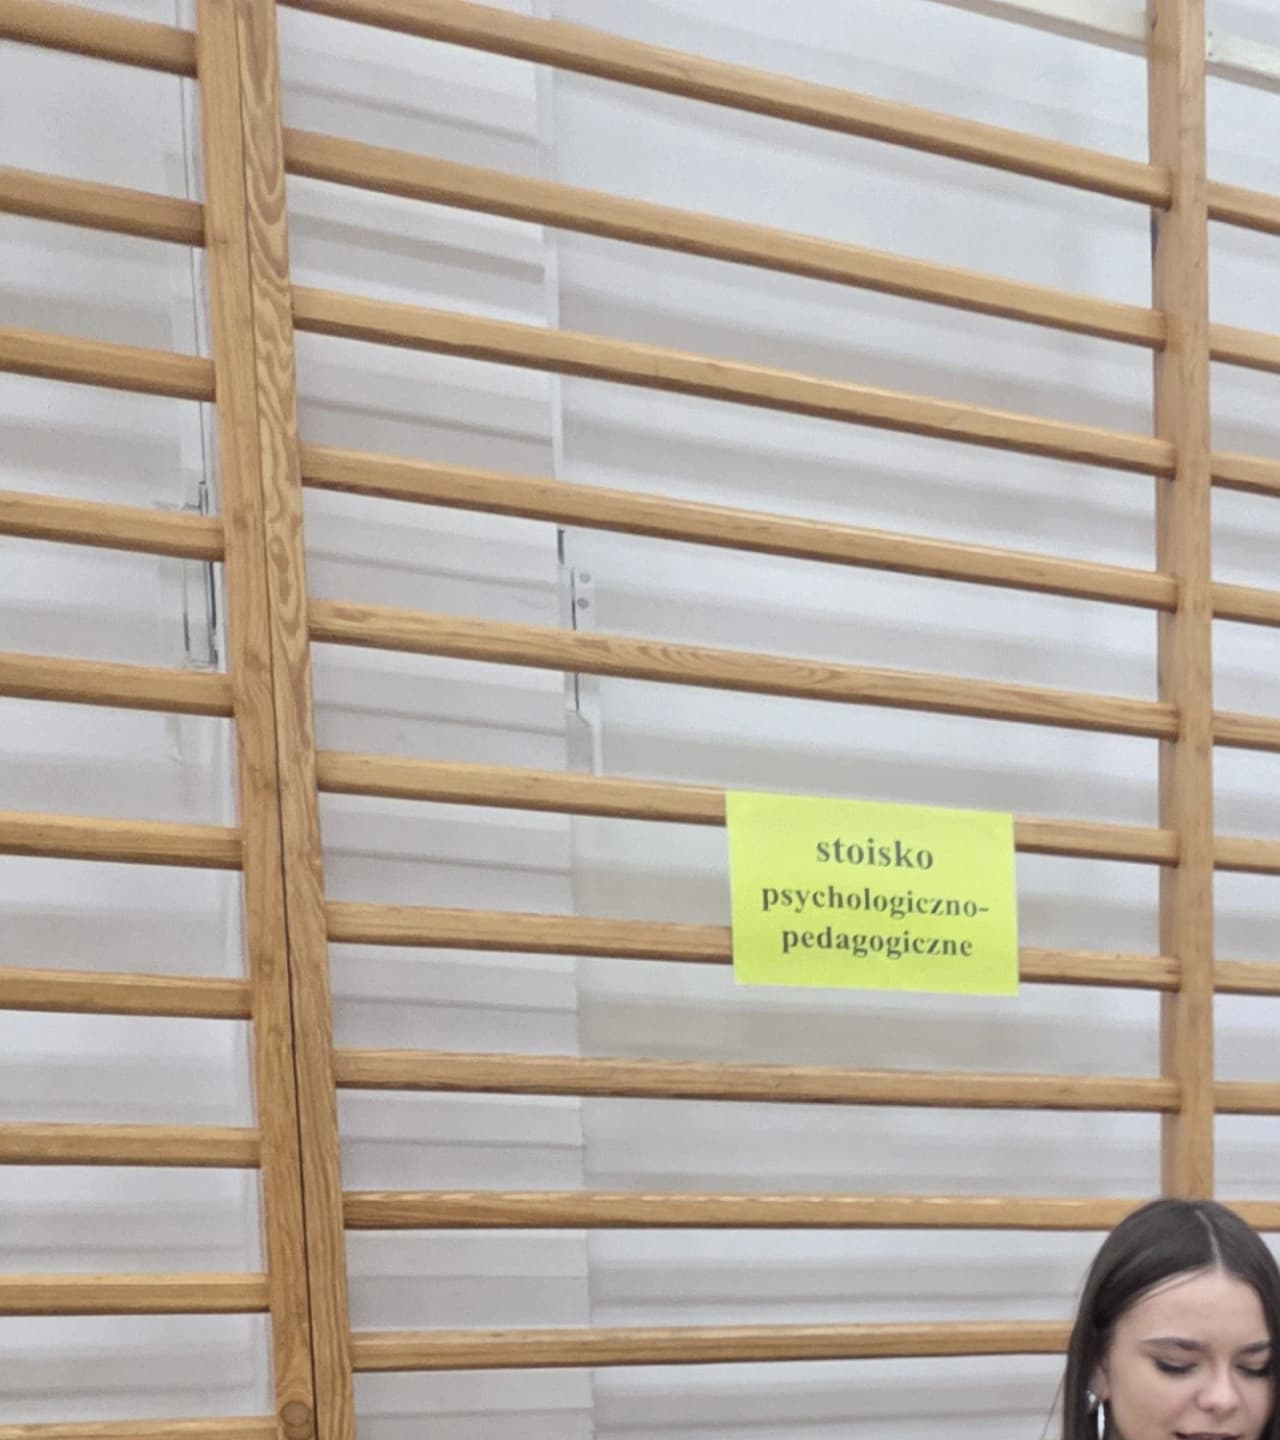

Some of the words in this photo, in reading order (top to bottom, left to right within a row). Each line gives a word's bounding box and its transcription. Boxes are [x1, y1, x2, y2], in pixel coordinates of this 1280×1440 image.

[816, 837, 934, 869] stoisko
[762, 885, 989, 918] psychologiczno-
[782, 927, 973, 958] pedagogiczne
